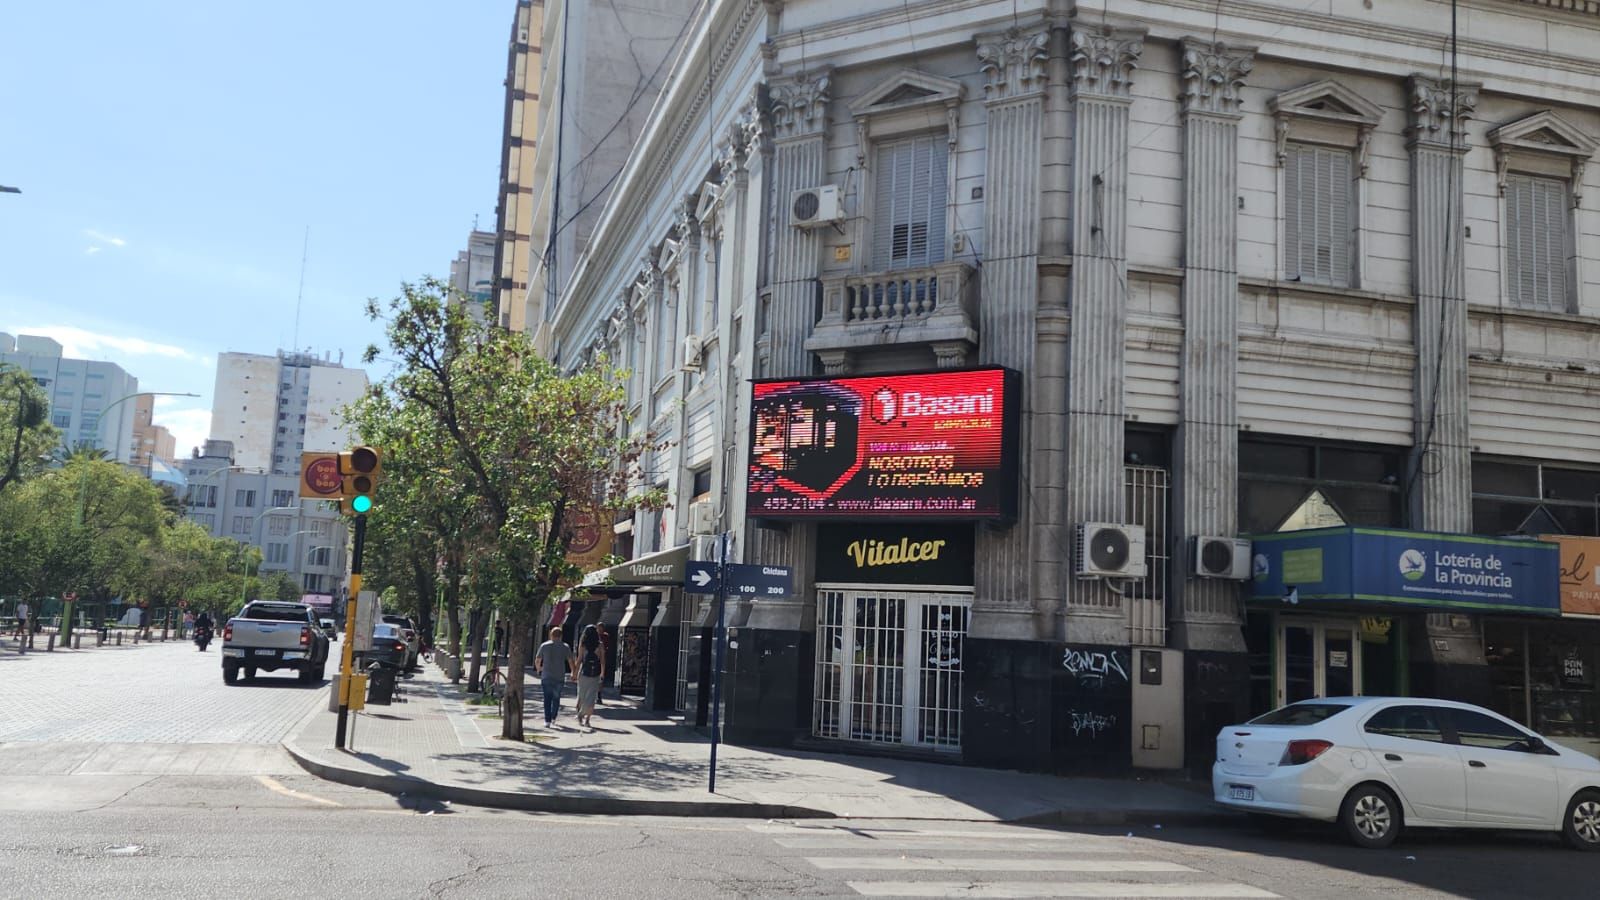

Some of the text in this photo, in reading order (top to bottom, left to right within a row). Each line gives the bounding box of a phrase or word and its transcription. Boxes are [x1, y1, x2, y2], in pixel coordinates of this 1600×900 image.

[902, 388, 993, 416] Basani
[847, 536, 946, 568] Vitalcer
[1435, 551, 1502, 570] Lotería de
[629, 563, 673, 576] Vitalcer
[1435, 567, 1512, 588] la Provincia
[739, 585, 784, 594] 100 200
